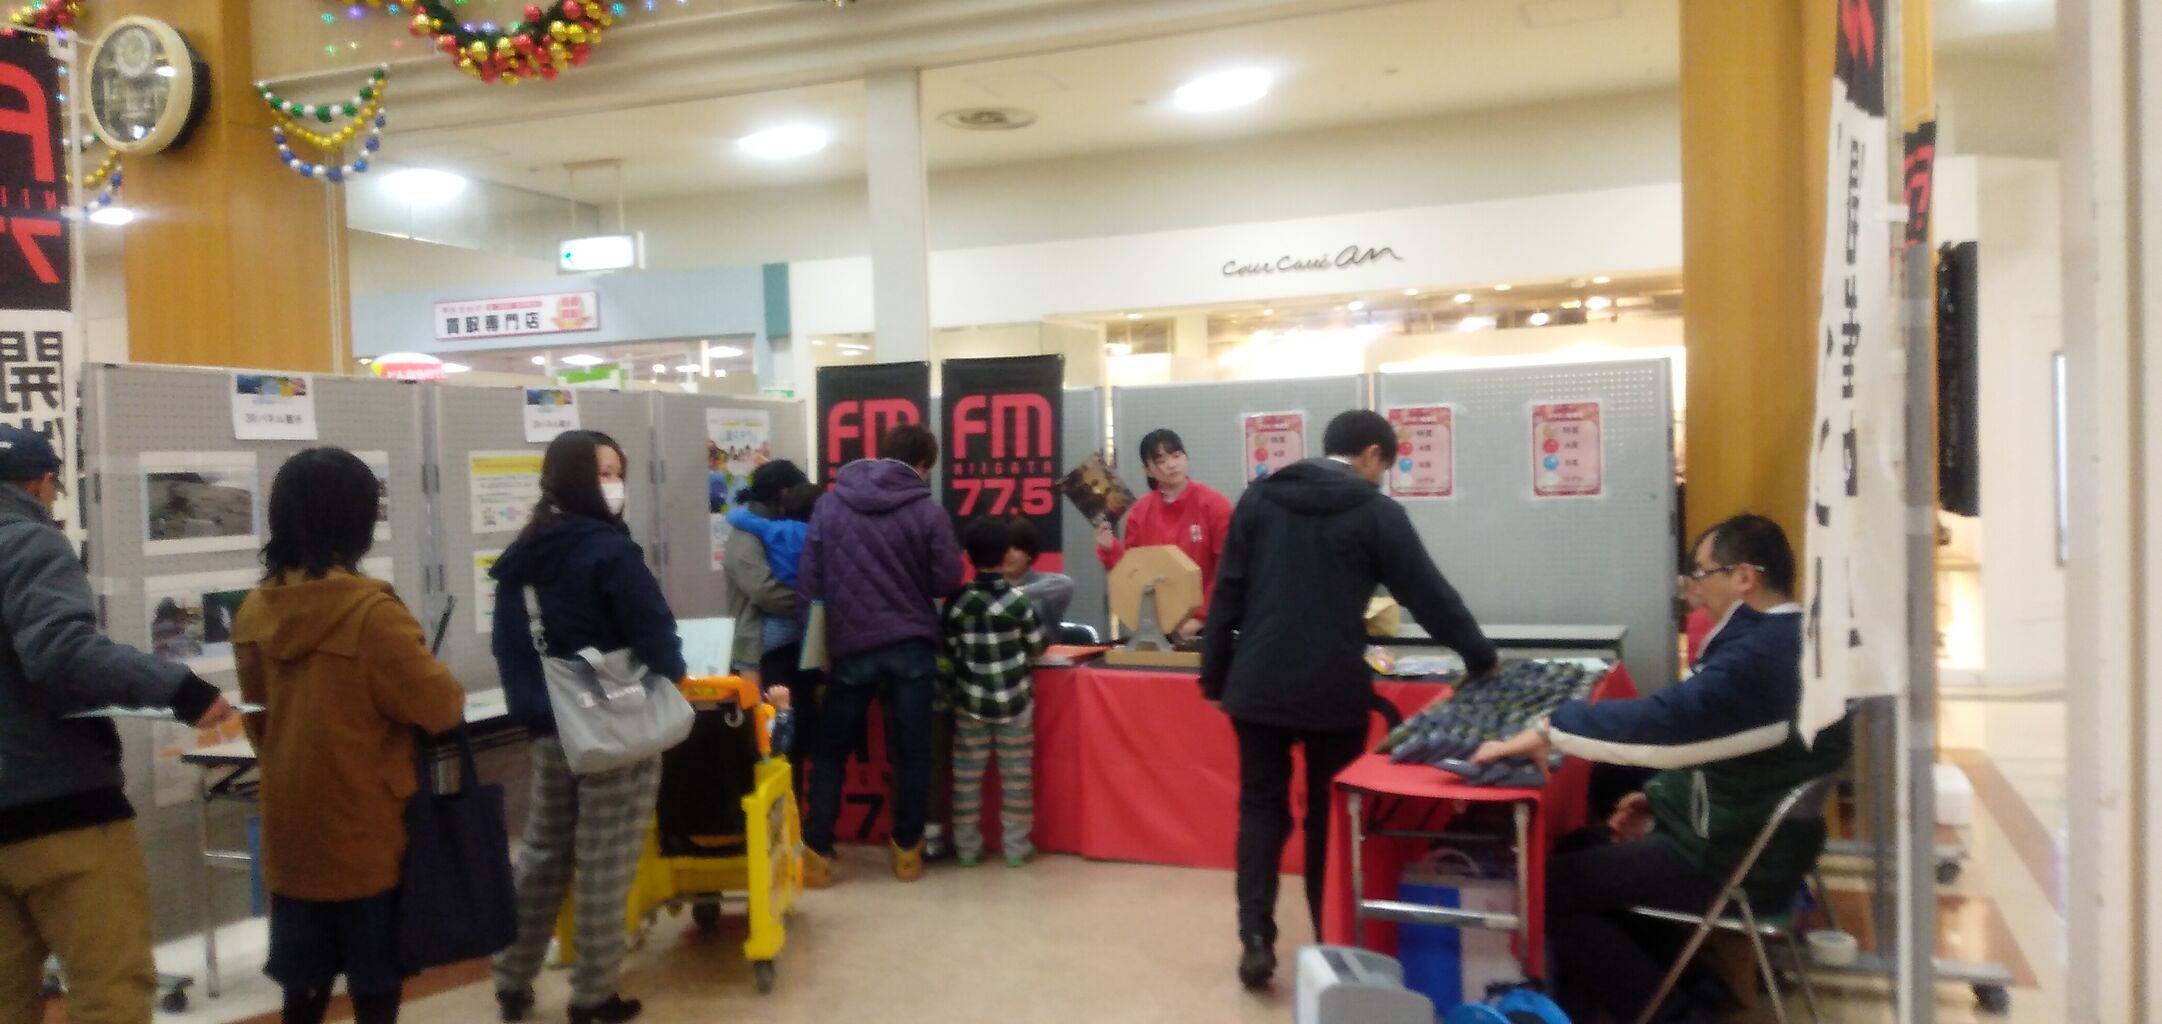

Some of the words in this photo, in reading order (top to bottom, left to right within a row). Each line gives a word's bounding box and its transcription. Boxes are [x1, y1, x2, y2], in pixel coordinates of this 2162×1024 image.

[446, 312, 540, 334] 買取専門店
[952, 393, 1054, 460] FM
[953, 461, 1054, 476] NIIGATA
[952, 478, 1054, 517] 77.5
